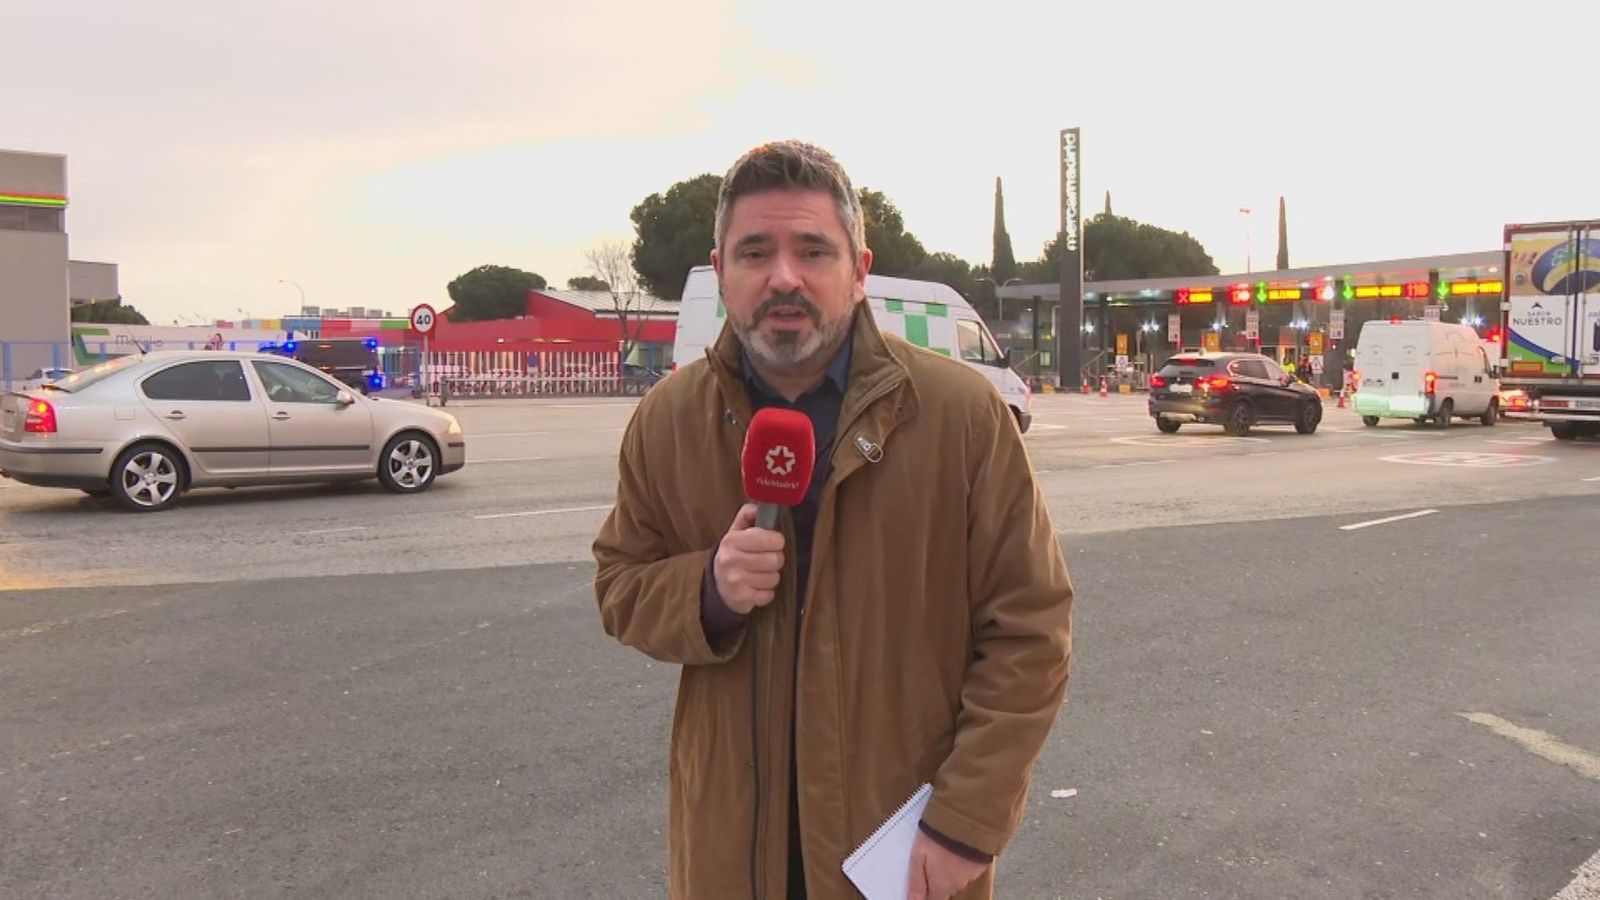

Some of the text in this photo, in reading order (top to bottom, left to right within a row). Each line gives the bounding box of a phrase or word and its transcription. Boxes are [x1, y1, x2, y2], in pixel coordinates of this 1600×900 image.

[1063, 132, 1078, 251] mercamadrid
[416, 315, 431, 325] 40
[1513, 317, 1562, 326] NUESTRO
